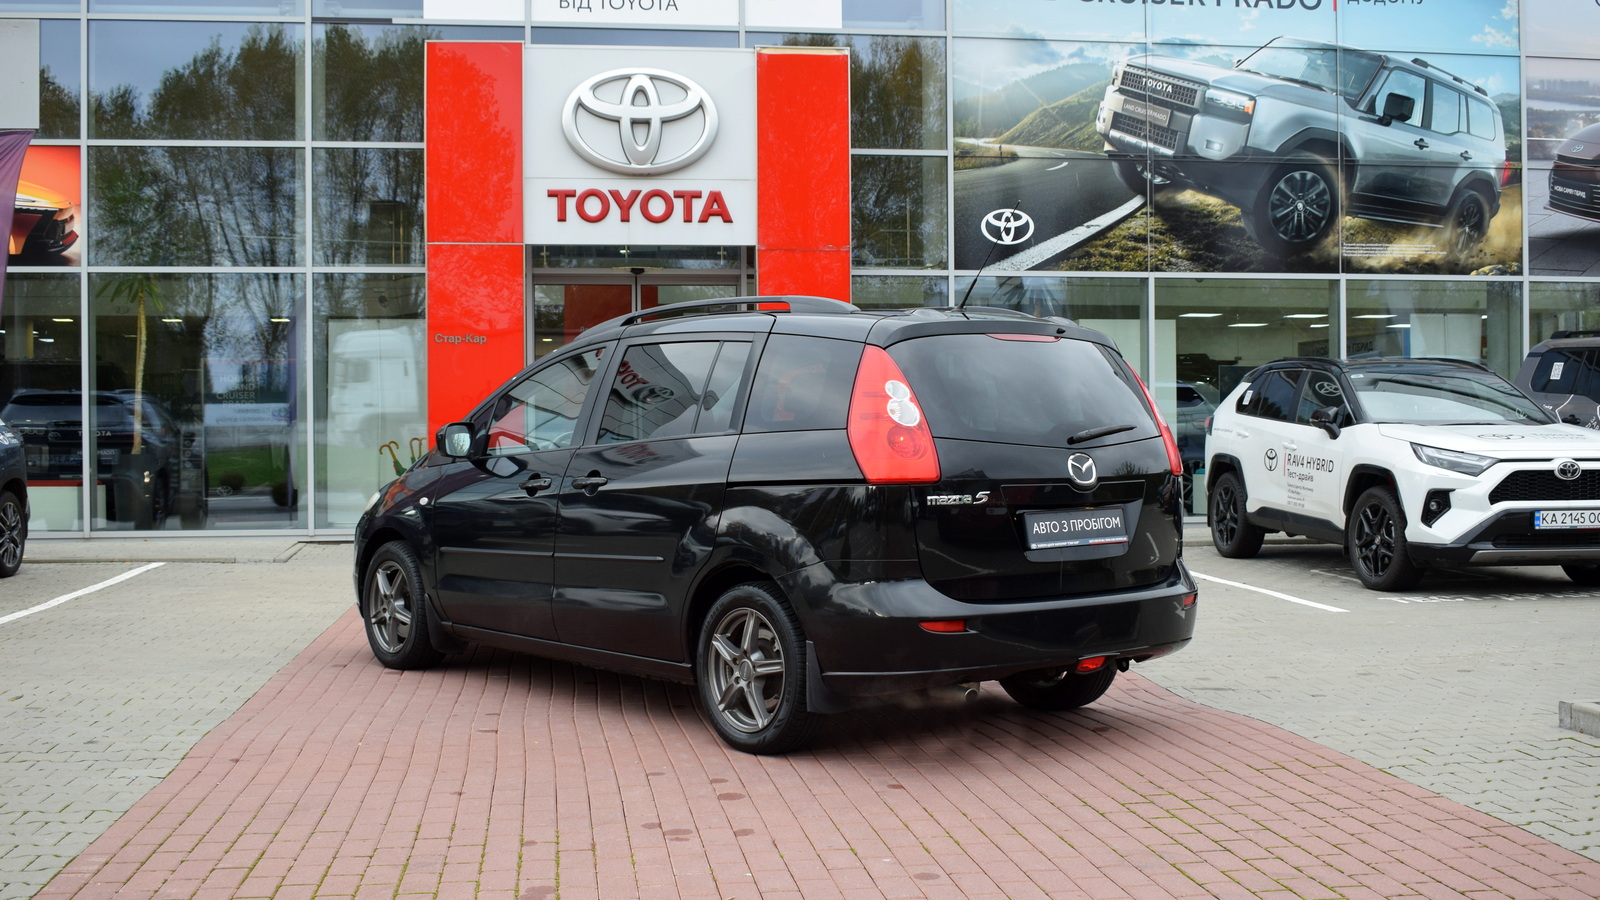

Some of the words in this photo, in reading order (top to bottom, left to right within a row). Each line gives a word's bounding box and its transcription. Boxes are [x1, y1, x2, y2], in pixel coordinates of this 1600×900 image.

[1142, 78, 1173, 93] TOYOTA
[547, 188, 734, 224] TOYOTA
[434, 333, 487, 345] Стар-Кар
[216, 391, 256, 400] CRUISER
[1286, 453, 1305, 468] RAV4
[1305, 456, 1335, 473] HYBRID
[1287, 468, 1314, 482] Тест-драйв
[973, 490, 991, 505] 5
[1033, 521, 1060, 534] АВТО
[1070, 516, 1121, 531] ПРОБІГОМ
[1560, 512, 1586, 524] 2145
